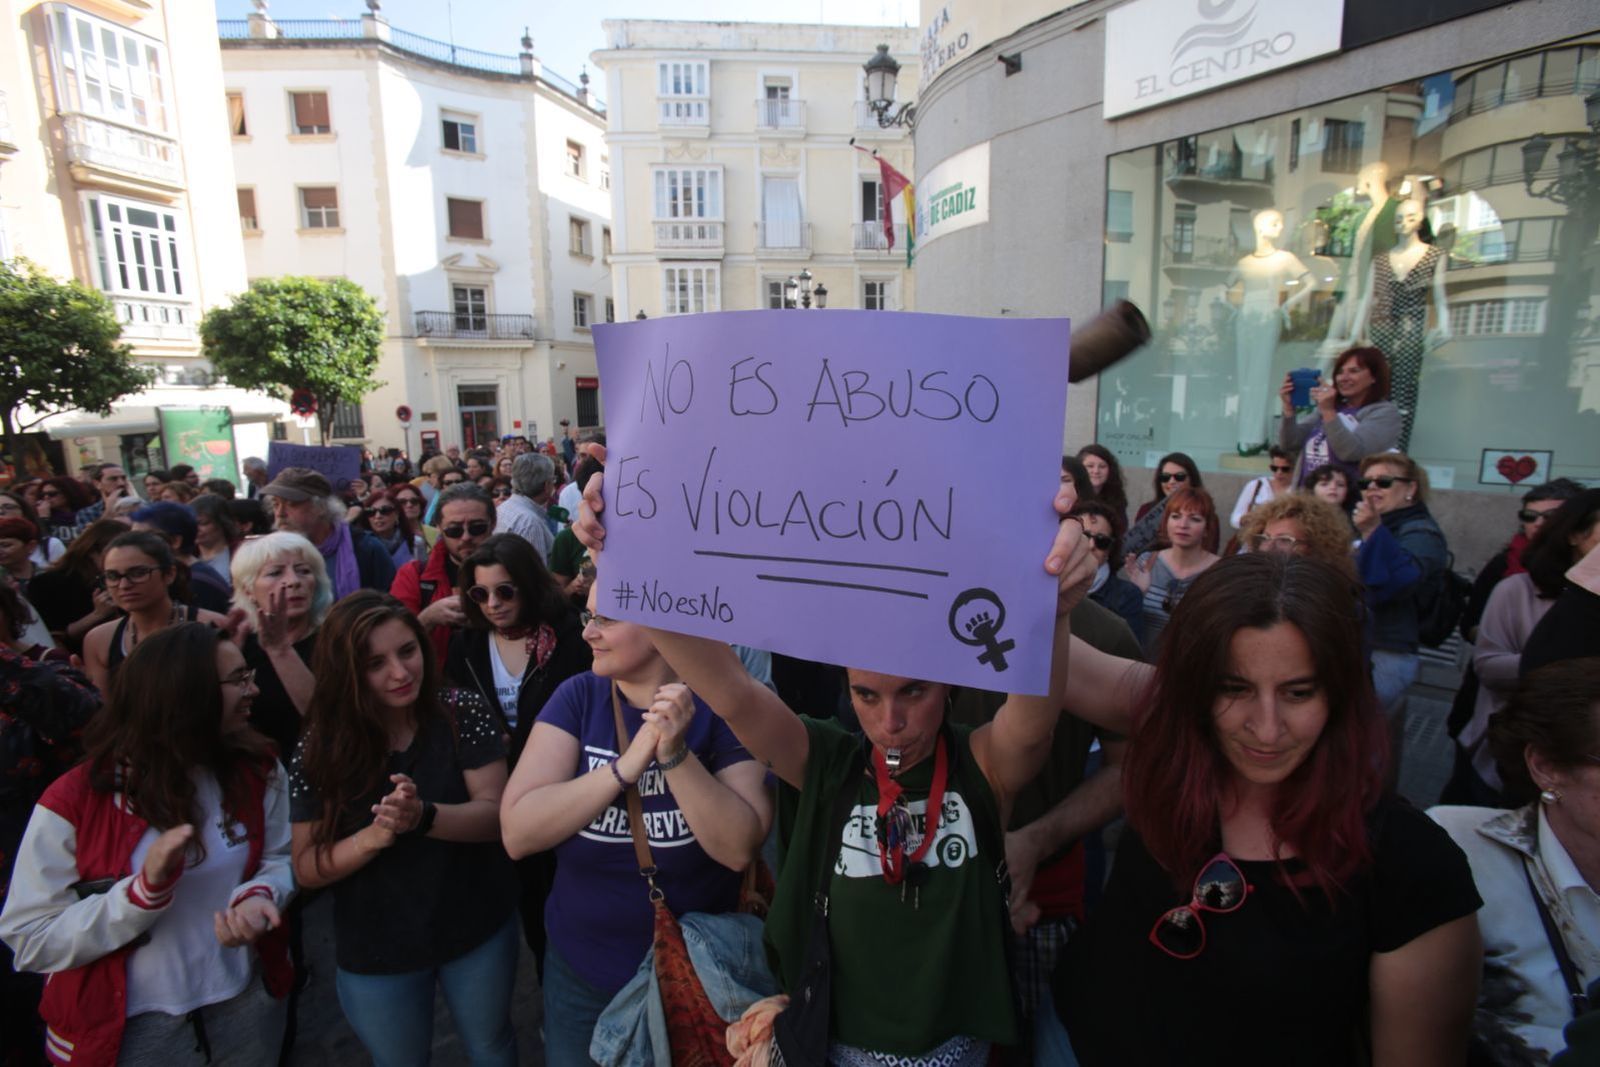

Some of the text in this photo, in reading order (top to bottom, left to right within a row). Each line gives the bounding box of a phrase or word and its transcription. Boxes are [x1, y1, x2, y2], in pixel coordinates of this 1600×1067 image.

[1134, 31, 1296, 99] EL CENTRO
[641, 342, 1000, 427] NO ES ABUSO
[615, 456, 657, 519] ES
